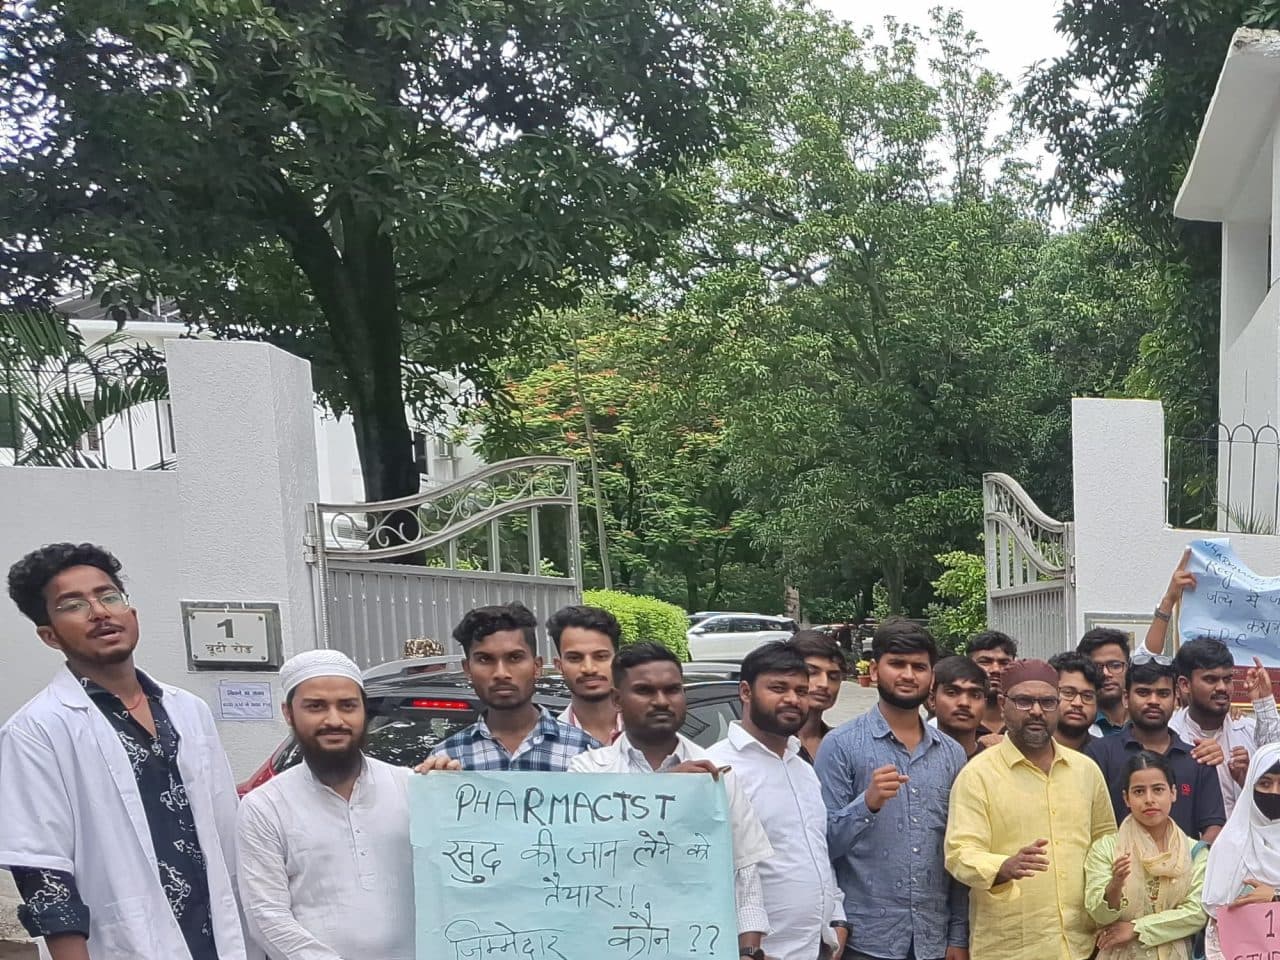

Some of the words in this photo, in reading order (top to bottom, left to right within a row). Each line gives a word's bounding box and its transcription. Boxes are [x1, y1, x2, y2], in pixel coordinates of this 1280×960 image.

[216, 618, 234, 639] 1
[441, 839, 505, 884] खुद
[520, 828, 564, 871] की
[566, 839, 628, 878] जान
[633, 830, 674, 867] लेने
[686, 832, 712, 861] को
